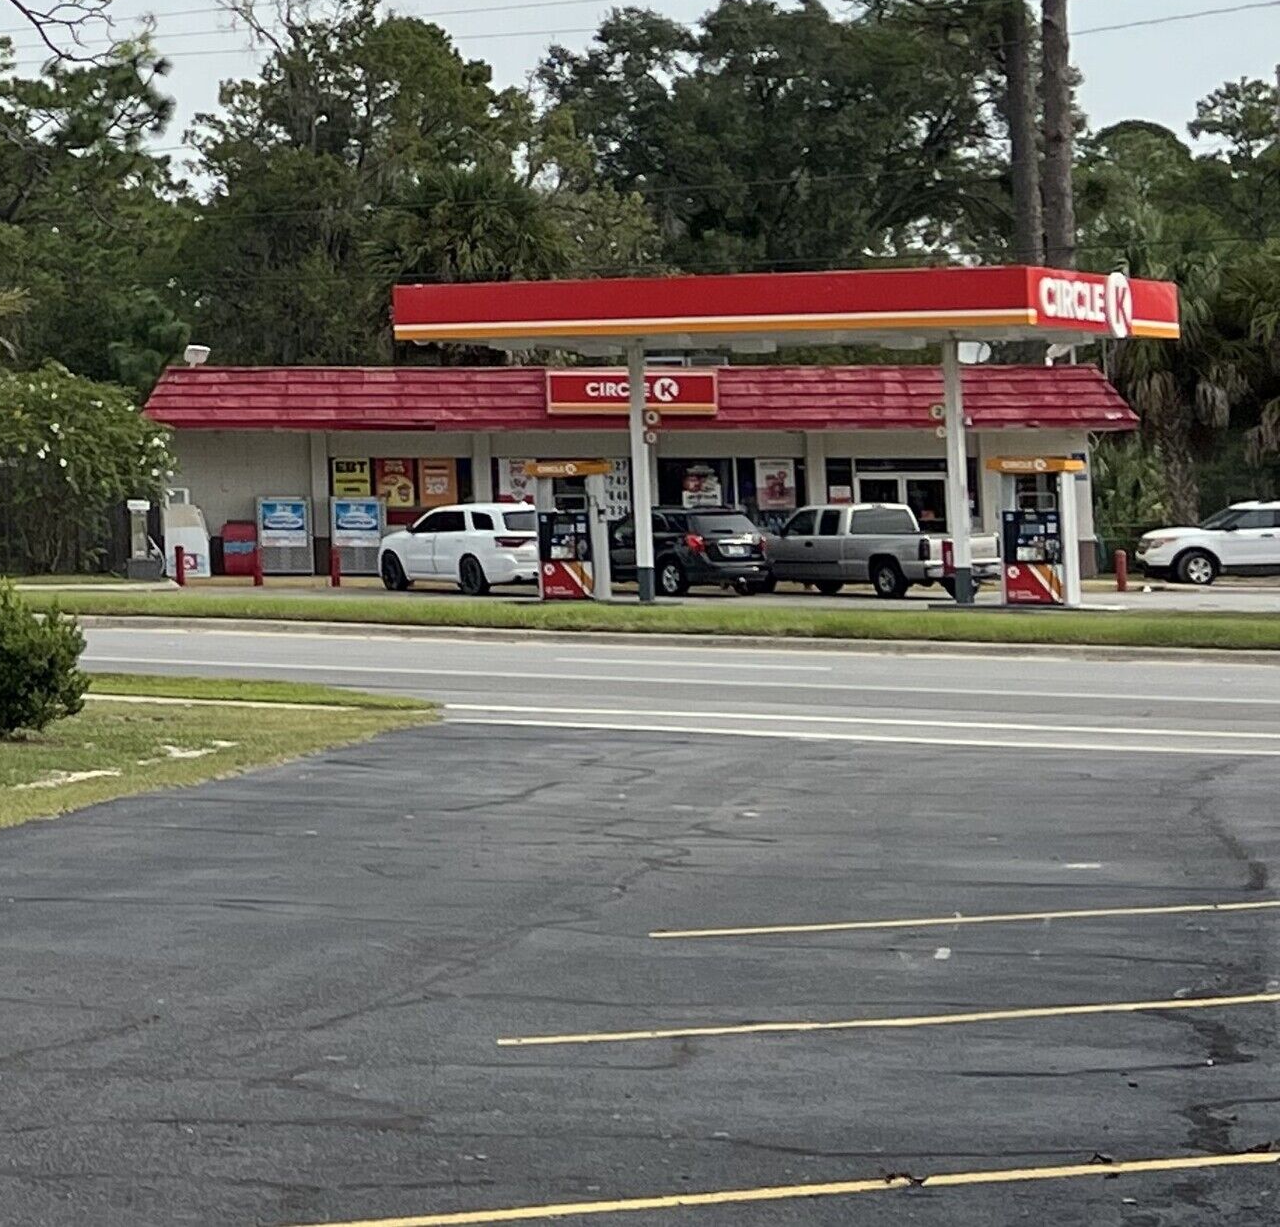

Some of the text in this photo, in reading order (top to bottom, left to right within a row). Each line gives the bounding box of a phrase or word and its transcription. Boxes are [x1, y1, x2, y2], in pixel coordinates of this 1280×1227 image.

[1040, 277, 1106, 323] CIRCLE
[585, 382, 651, 397] CIRCE
[336, 461, 367, 473] EBT
